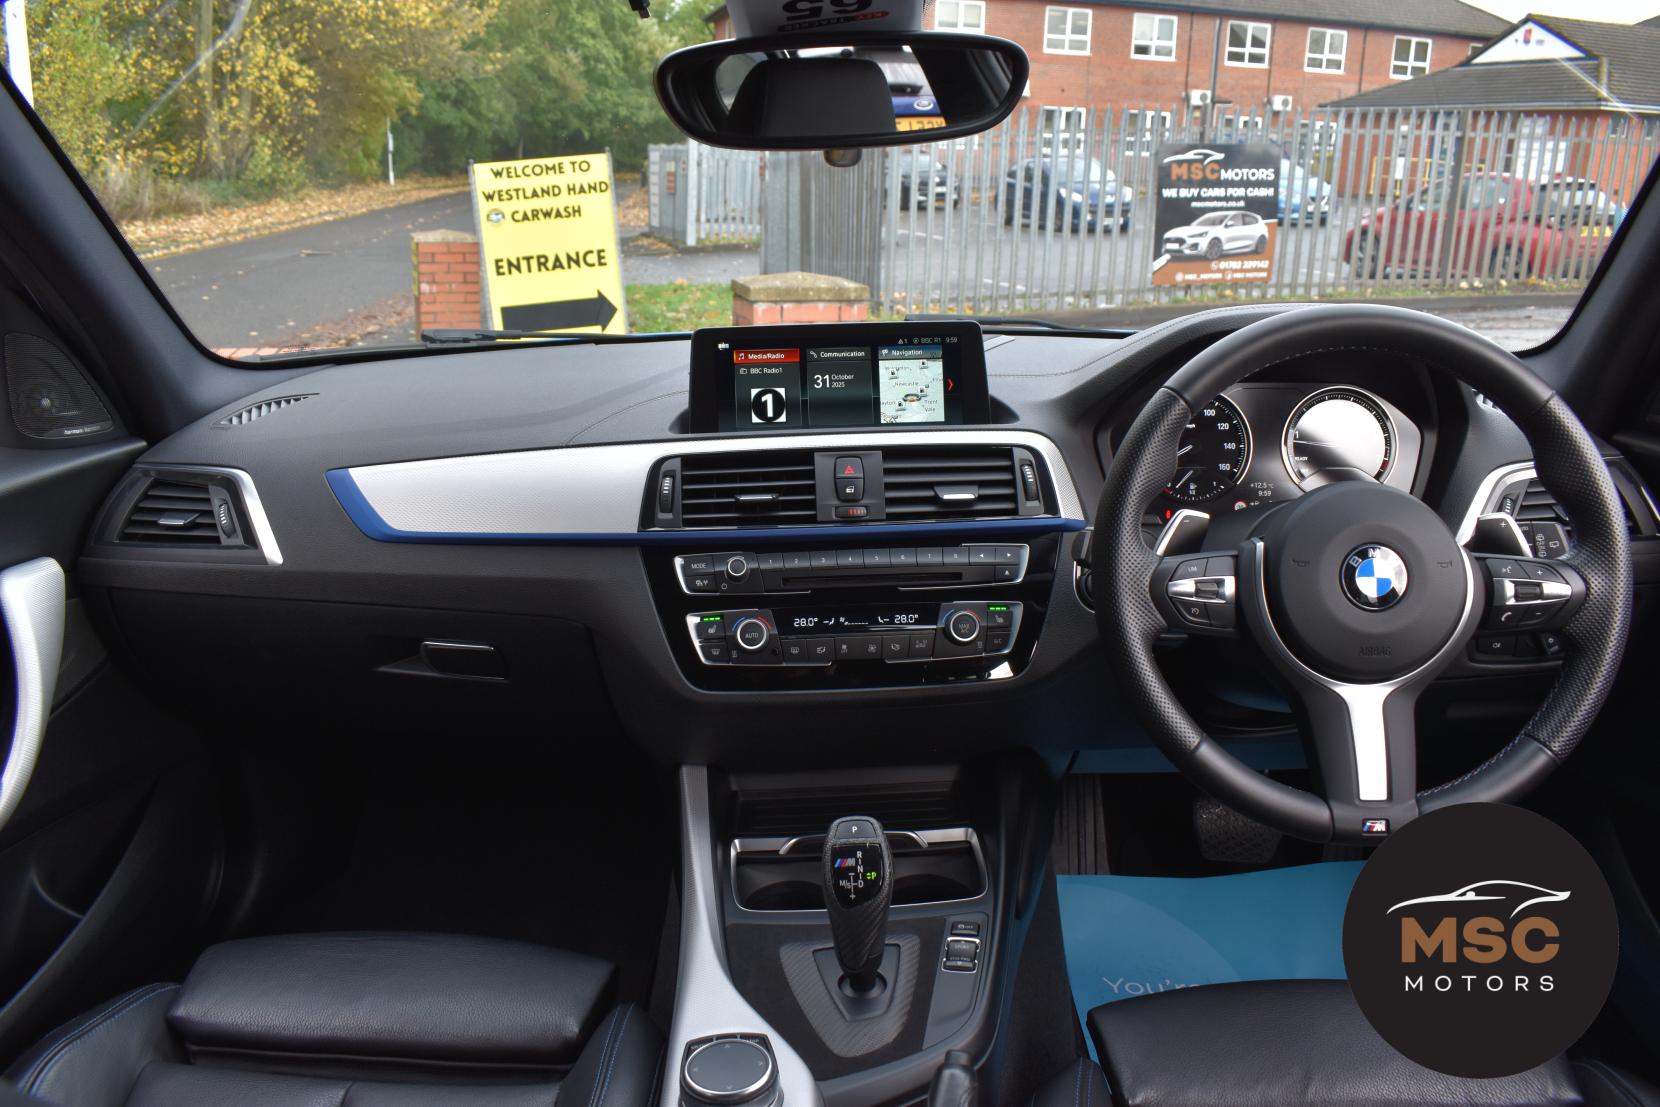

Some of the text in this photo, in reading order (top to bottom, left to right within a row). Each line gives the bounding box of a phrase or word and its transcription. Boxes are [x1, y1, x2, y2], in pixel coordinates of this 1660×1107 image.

[490, 160, 591, 179] WELCOME TO
[1170, 162, 1275, 181] MSC MOTORS
[482, 180, 609, 203] WESTLAND HAND
[1162, 188, 1178, 198] WE
[1179, 188, 1199, 198] BUY
[1200, 188, 1226, 197] CARS
[1226, 188, 1246, 197] FOR
[511, 205, 582, 223] CARWASH
[494, 248, 608, 277] ENTRANCE
[748, 352, 785, 360] Media/Radio
[820, 350, 866, 358] Communication
[891, 348, 923, 357] Navigation
[763, 366, 783, 374] Radio1
[813, 374, 830, 389] 31
[762, 393, 774, 418] 1
[1203, 408, 1216, 417] 100
[1217, 422, 1230, 430] 120
[1218, 463, 1231, 471] 160
[794, 617, 819, 627] 28.0°
[894, 614, 920, 624] 28.0°
[871, 872, 877, 880] P
